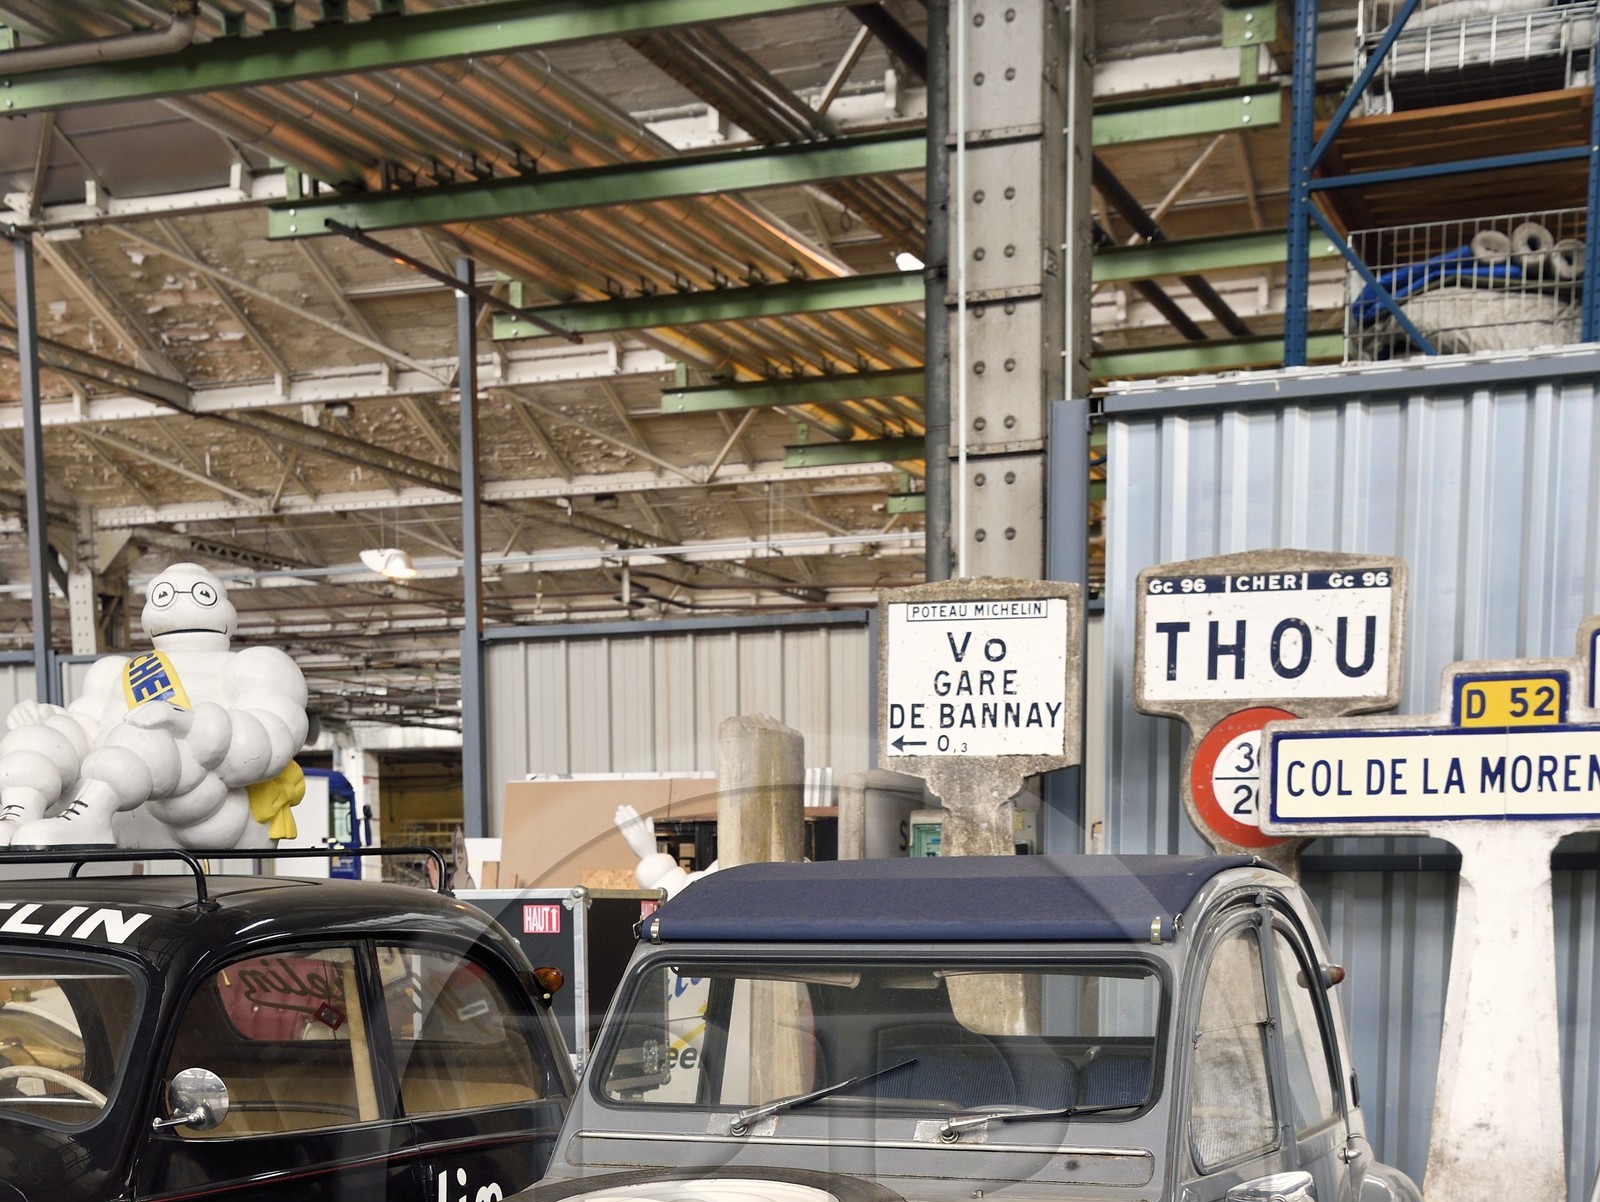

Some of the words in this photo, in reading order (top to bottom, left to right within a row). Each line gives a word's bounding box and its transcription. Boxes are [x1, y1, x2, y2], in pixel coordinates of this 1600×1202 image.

[1180, 577, 1207, 593] 96
[1235, 574, 1298, 591] CHER
[1362, 571, 1389, 587] 96
[912, 604, 968, 619] POTEAU
[974, 602, 1042, 617] MICHELIN
[1155, 615, 1377, 682] THOU
[933, 669, 1018, 697] GARE
[889, 703, 926, 729] DE
[939, 702, 1063, 729] BANNAY
[1466, 689, 1487, 719] D
[1509, 685, 1555, 718] 52
[1235, 741, 1261, 773] 3
[1286, 759, 1353, 797] COL
[1366, 758, 1407, 795] DE
[1422, 757, 1466, 795] LA
[1233, 784, 1260, 814] 2
[525, 906, 549, 932] HAUT
